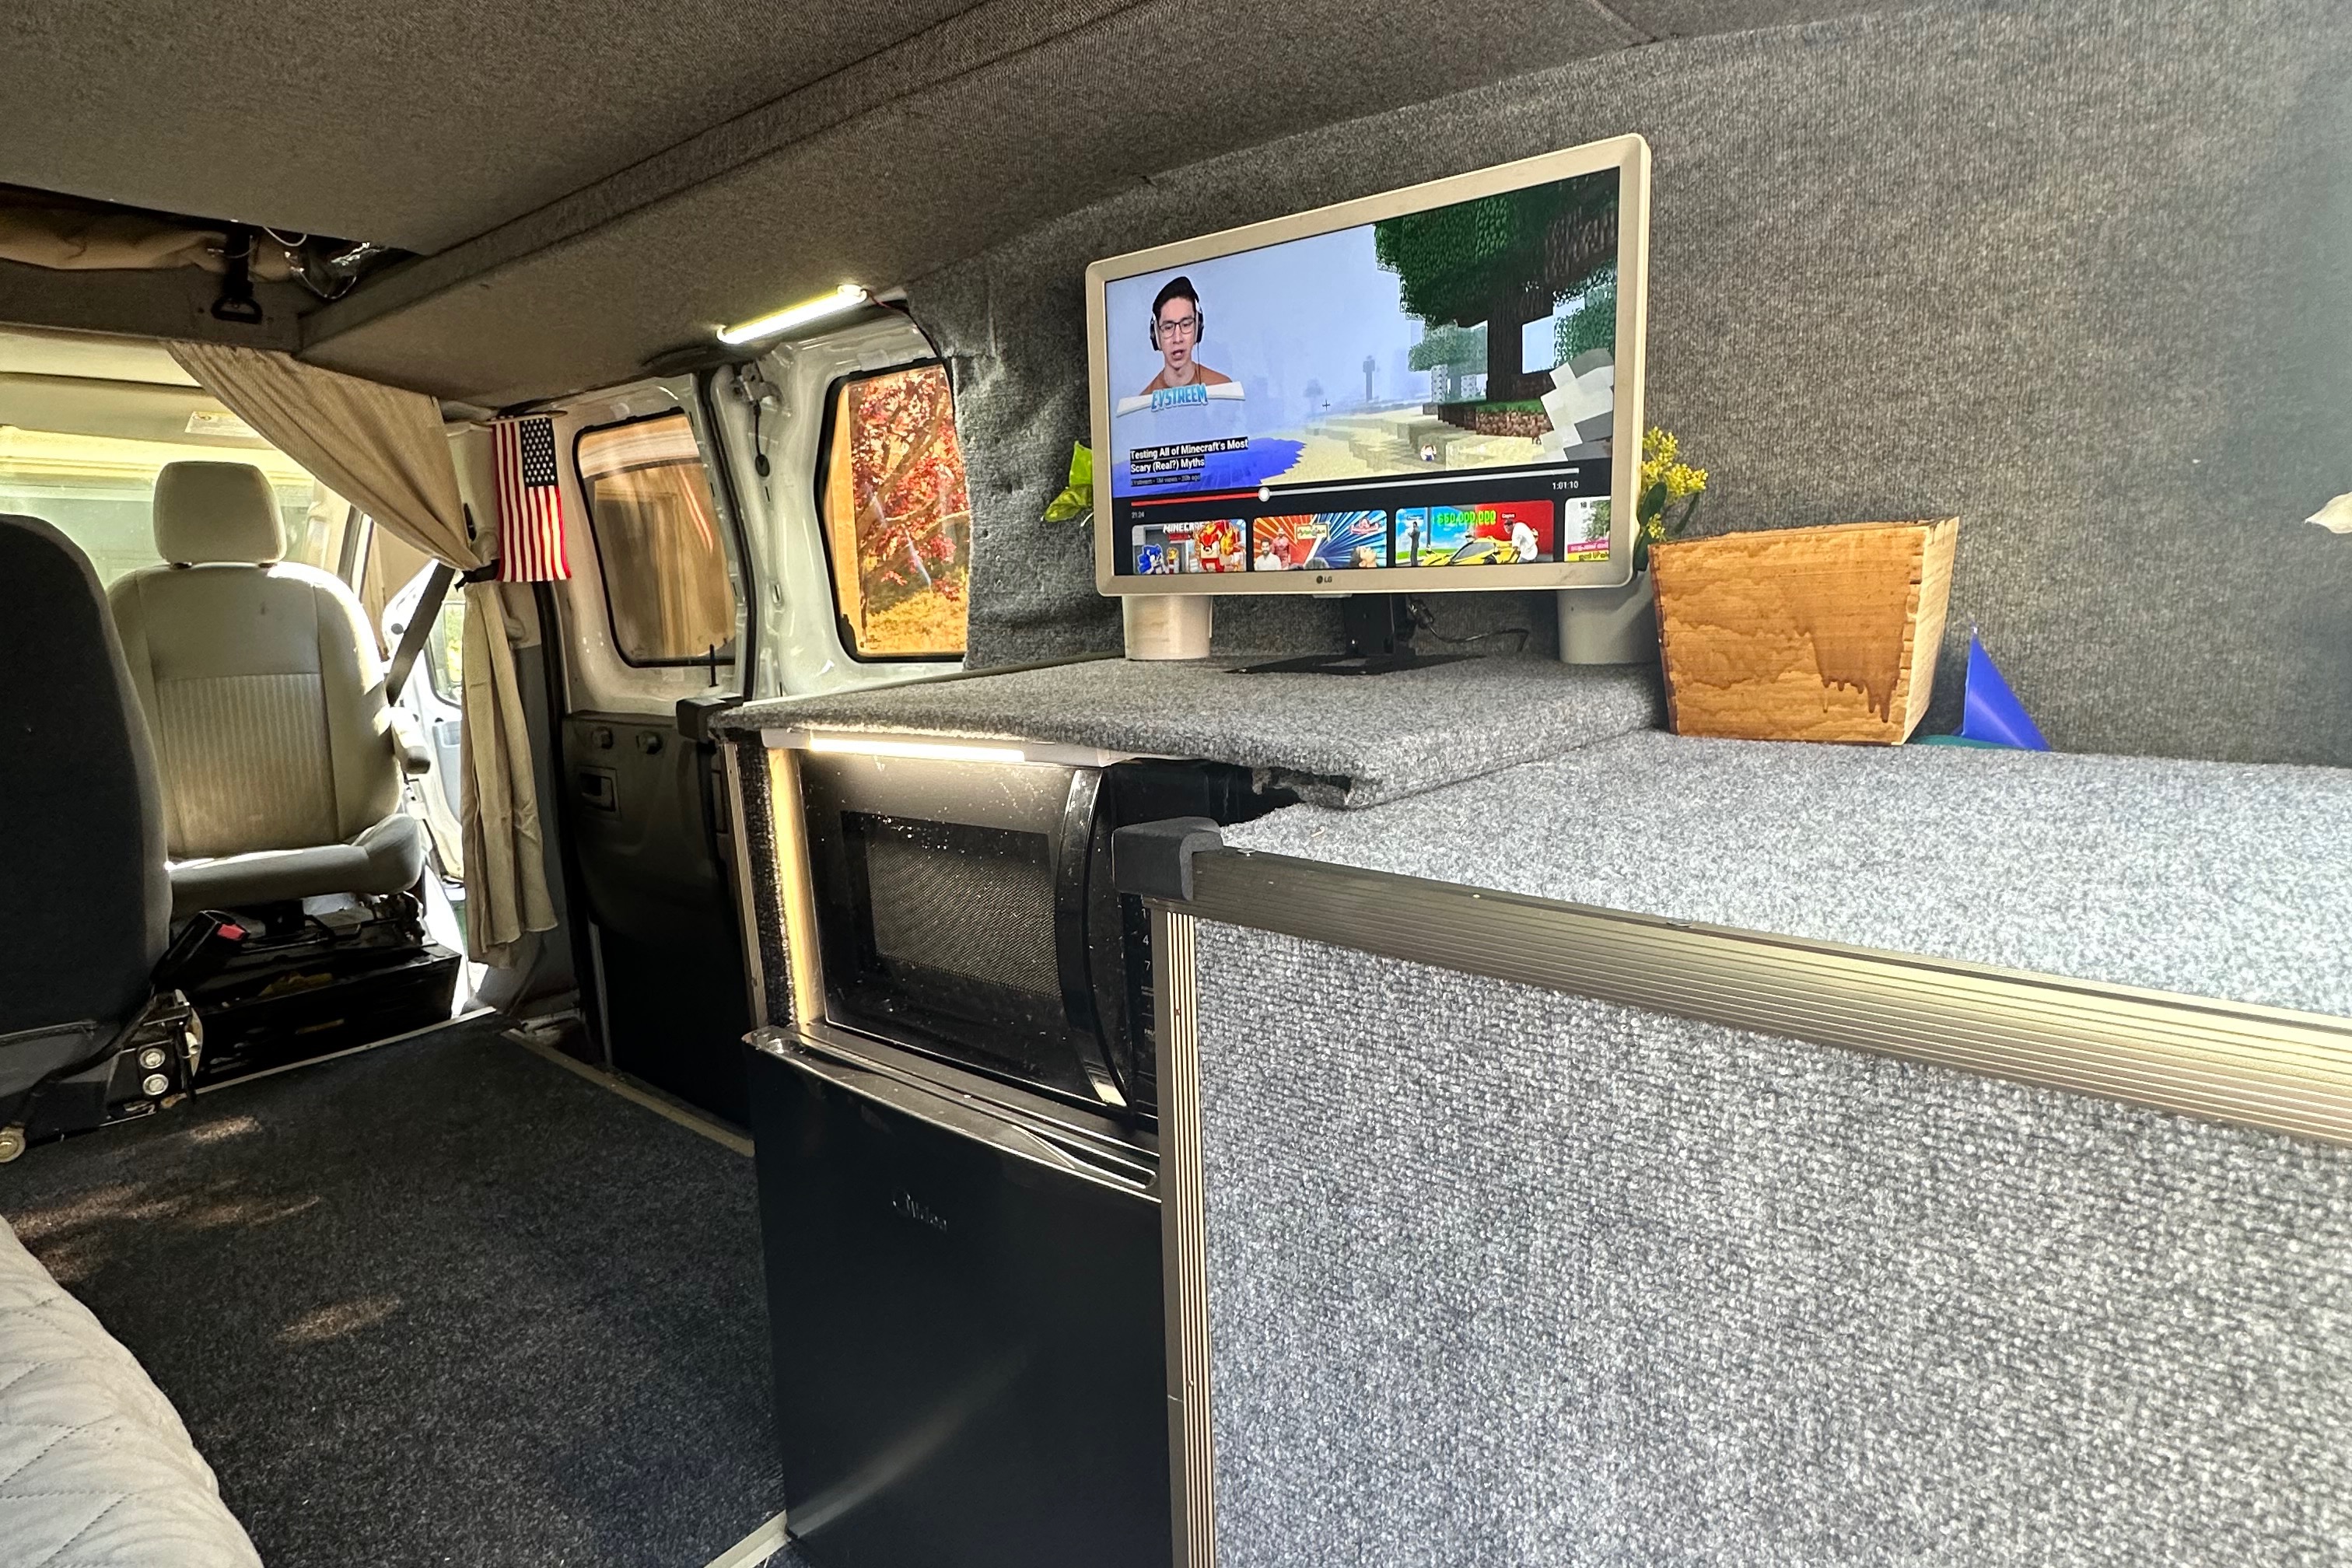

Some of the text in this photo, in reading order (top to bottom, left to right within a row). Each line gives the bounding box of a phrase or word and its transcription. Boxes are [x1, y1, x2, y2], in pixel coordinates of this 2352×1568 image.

[1151, 383, 1208, 411] EYSTREEM
[1131, 438, 1249, 460] Testing All of Minecraft's Most
[1130, 457, 1205, 474] Scary (Real?) Myths
[1552, 480, 1580, 490] 1:01:10
[1163, 521, 1206, 534] MINECRAF
[1143, 934, 1150, 945] 4
[1144, 960, 1151, 971] 7
